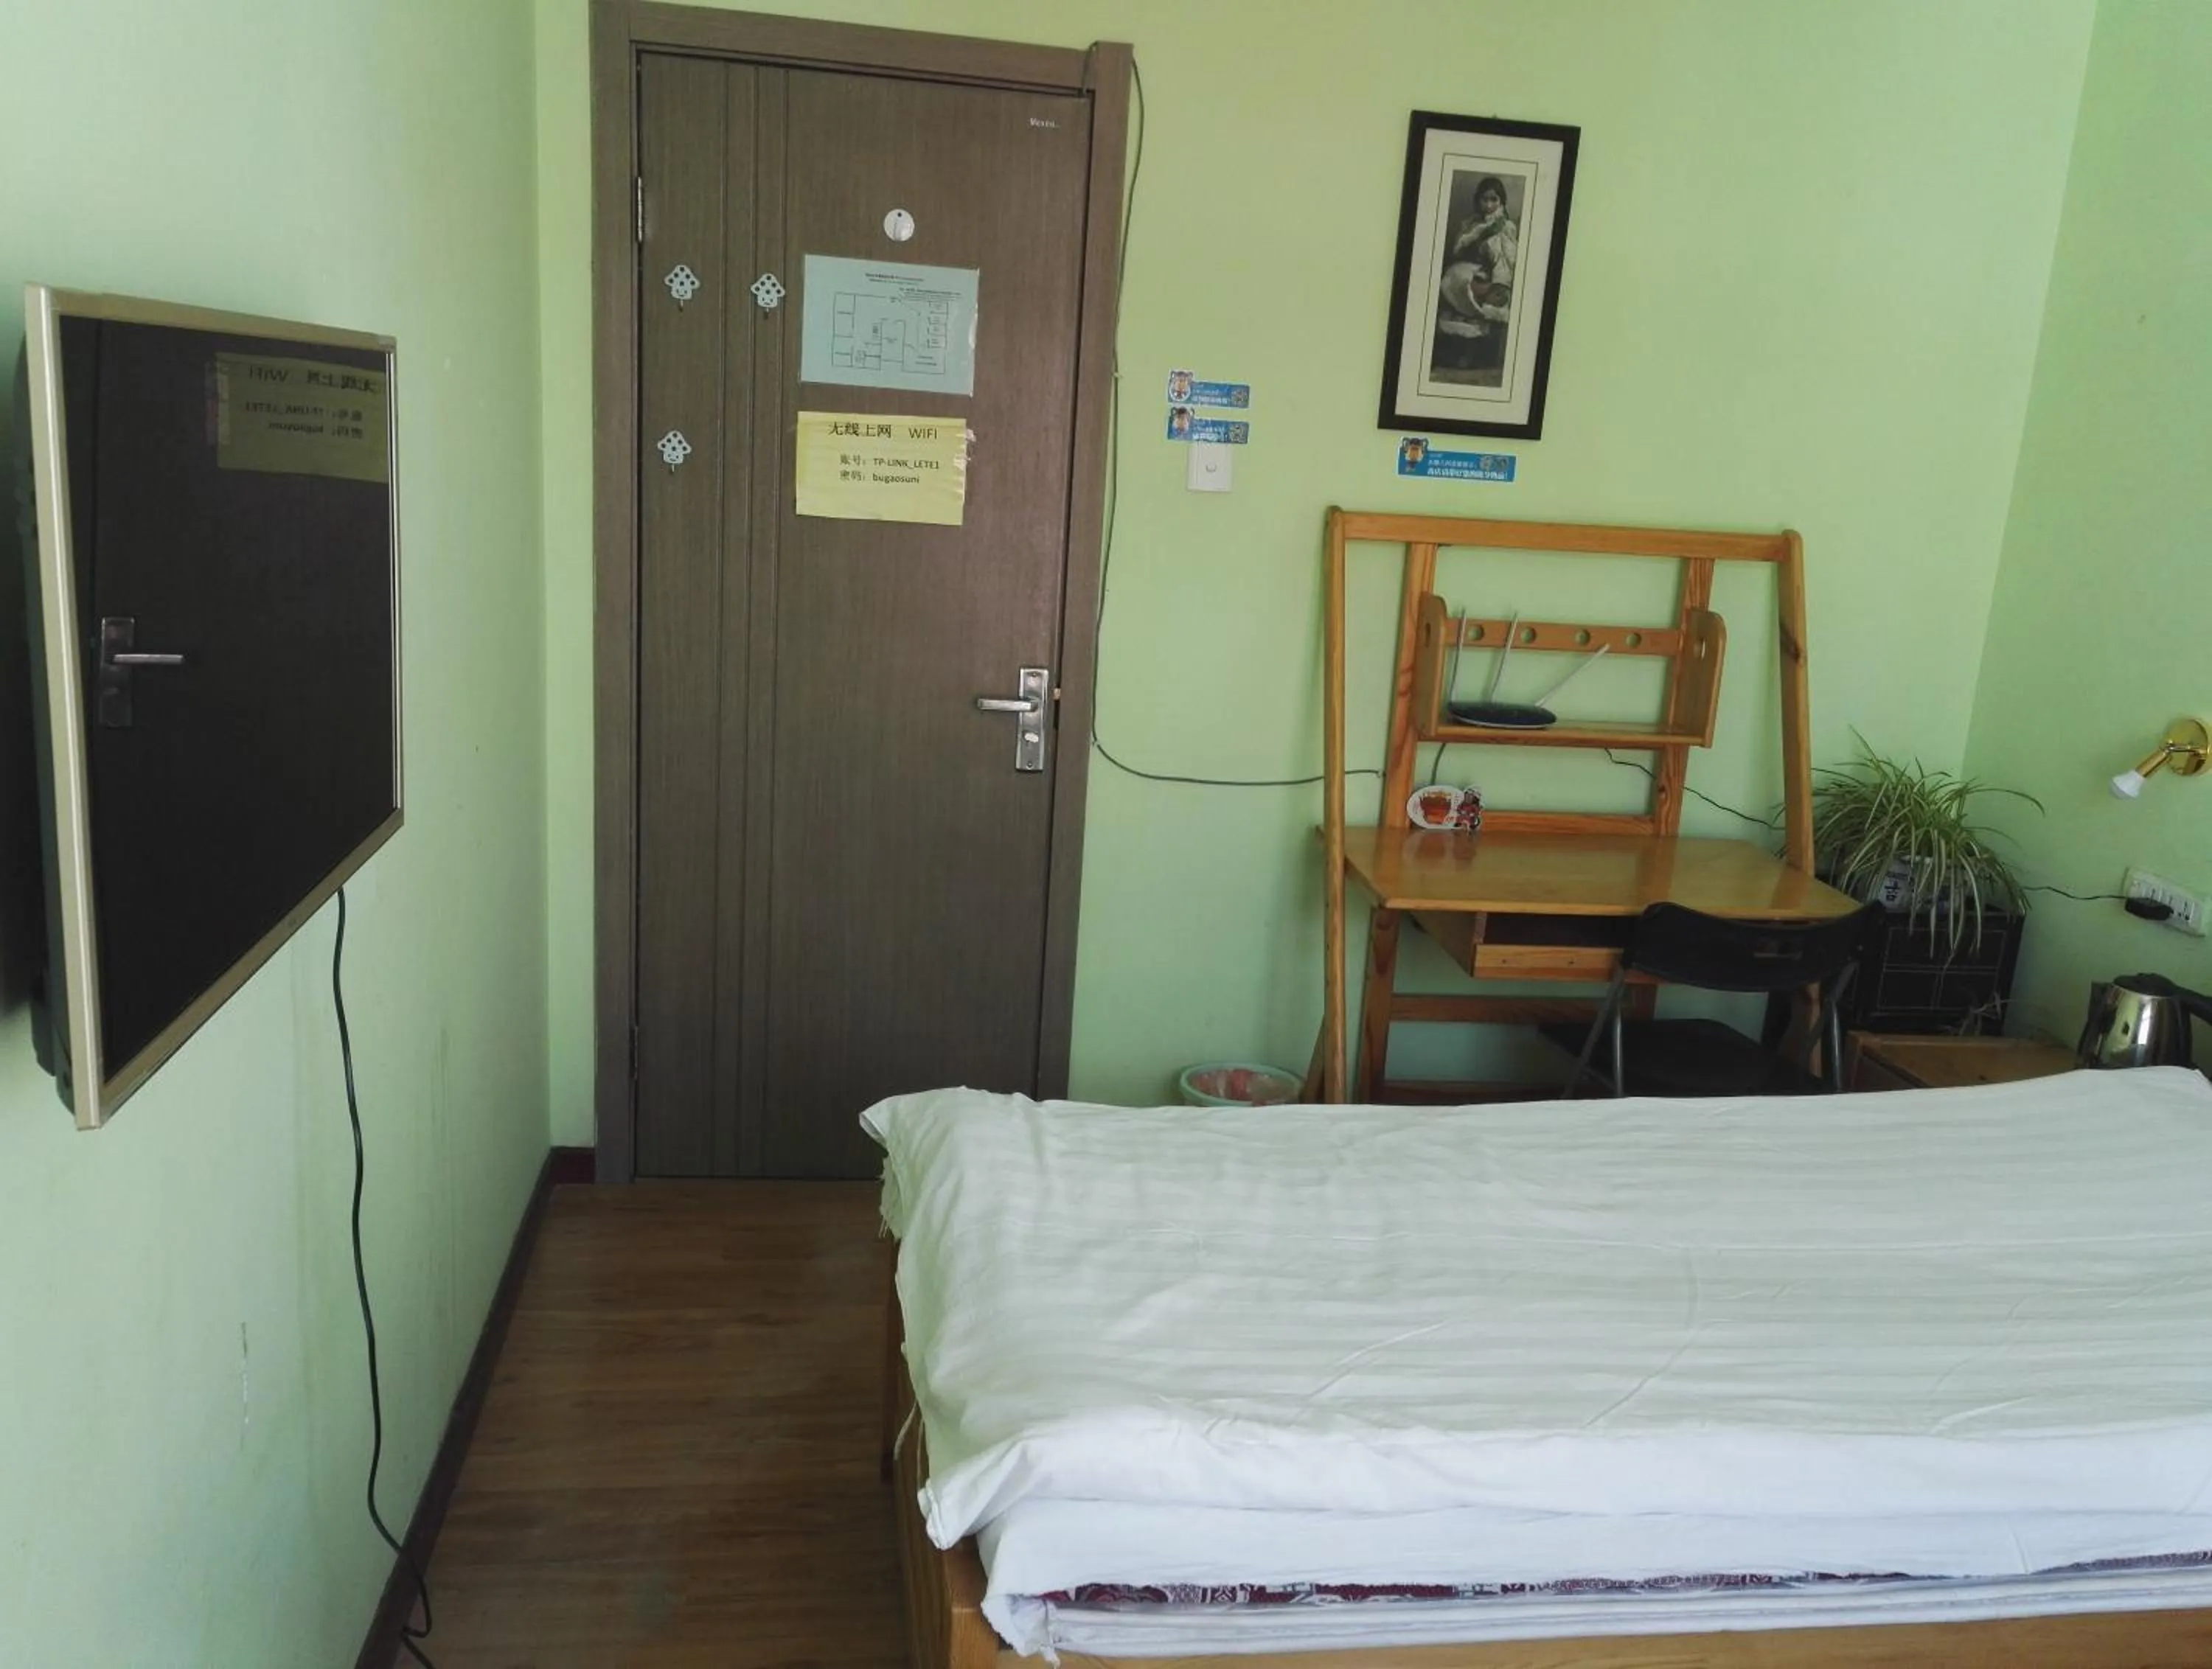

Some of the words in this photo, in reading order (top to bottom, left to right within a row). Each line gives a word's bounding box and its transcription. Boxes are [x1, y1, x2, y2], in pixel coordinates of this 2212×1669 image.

[828, 421, 891, 438] 无线上网
[908, 427, 938, 440] WIFI
[872, 473, 919, 484] bugaosuni
